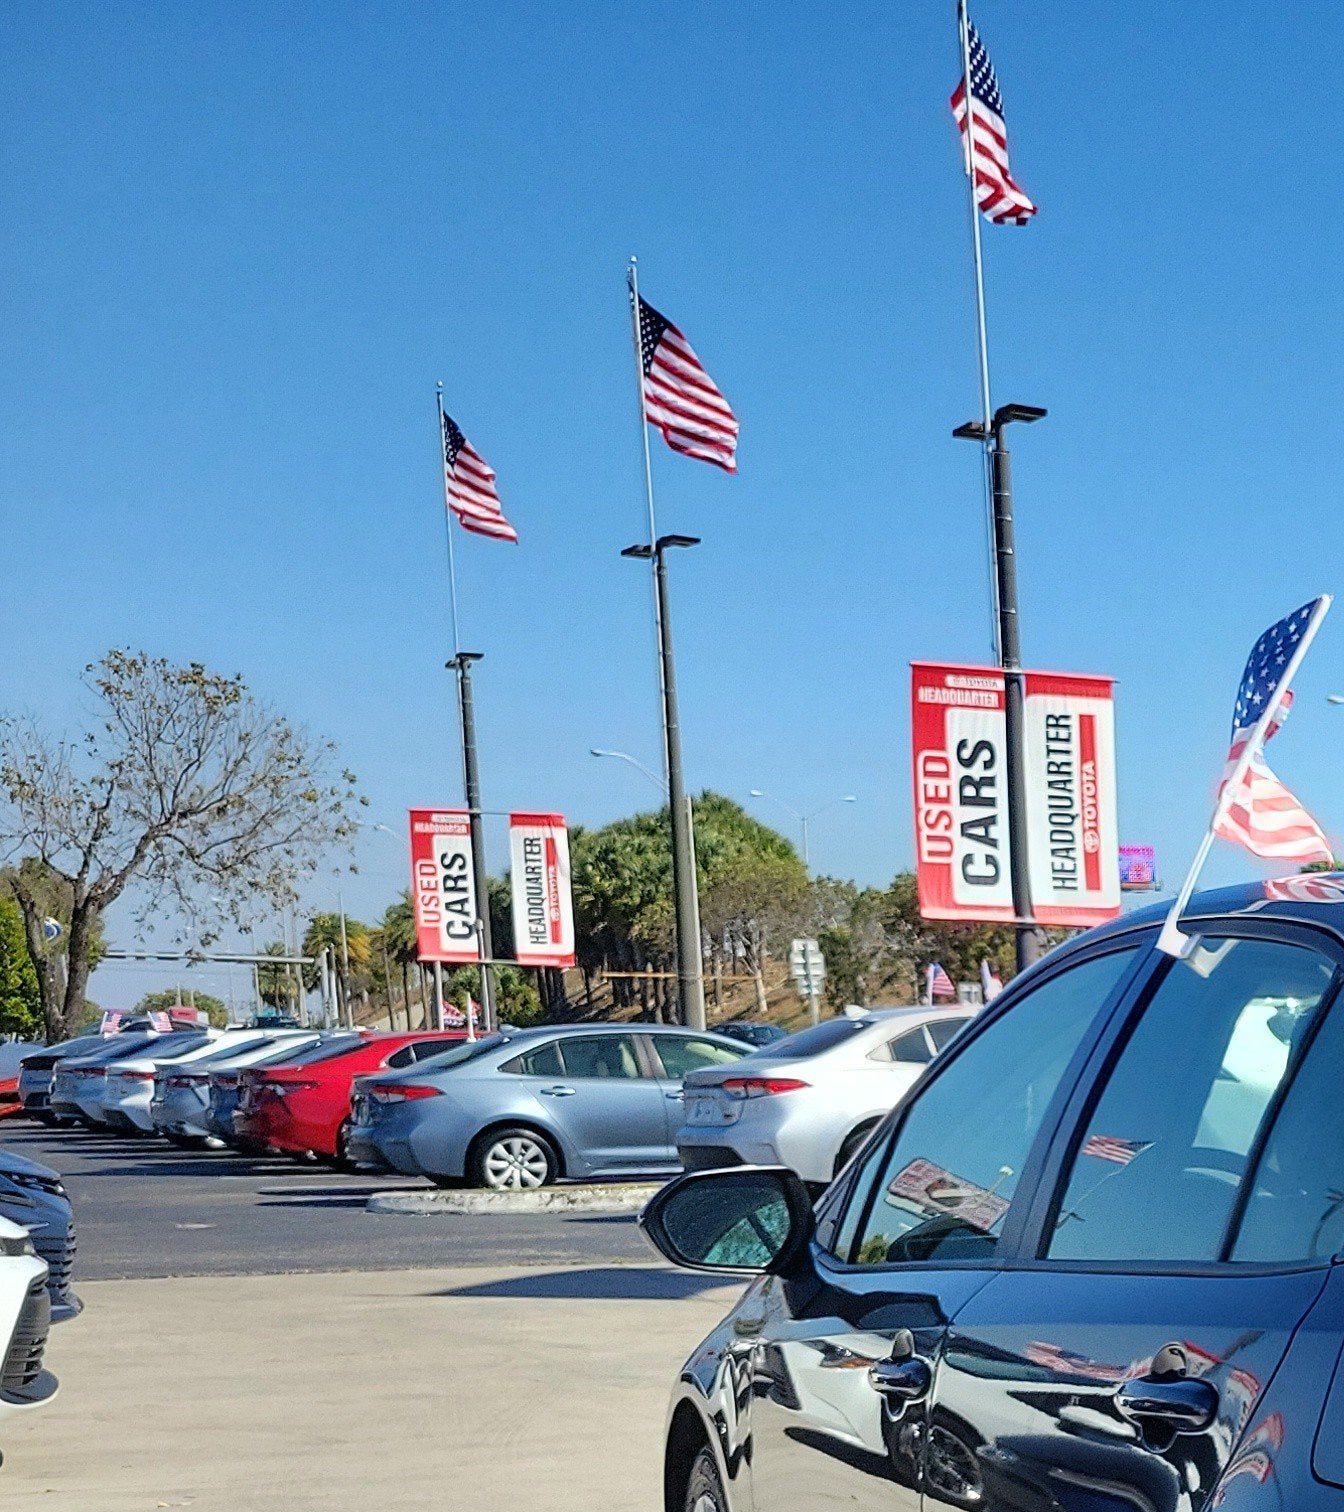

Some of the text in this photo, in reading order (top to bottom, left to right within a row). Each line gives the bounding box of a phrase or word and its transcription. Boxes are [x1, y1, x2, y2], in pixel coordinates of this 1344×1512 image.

[918, 687, 999, 708] HEADQUARTER
[923, 755, 953, 859] USED
[956, 738, 1000, 886] CARS
[1045, 713, 1079, 891] HEADQUARTER
[1080, 761, 1098, 823] TOYOTA
[419, 863, 441, 924] USED
[440, 852, 475, 940] CARS
[523, 837, 548, 945] HEADQUARTER
